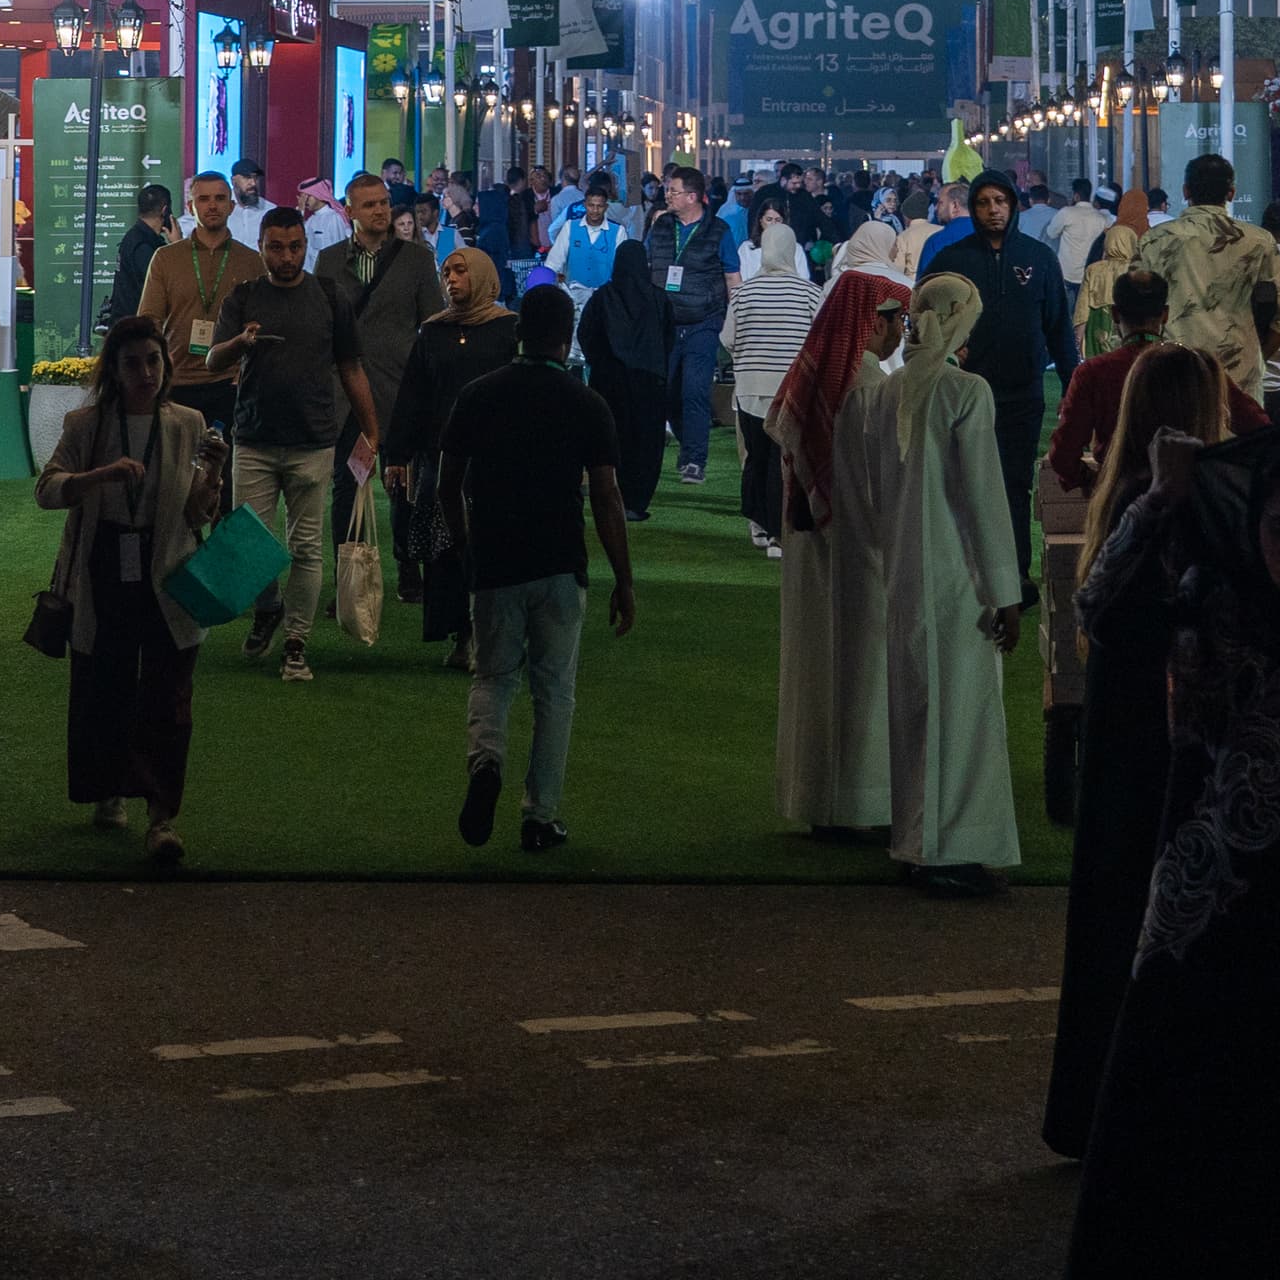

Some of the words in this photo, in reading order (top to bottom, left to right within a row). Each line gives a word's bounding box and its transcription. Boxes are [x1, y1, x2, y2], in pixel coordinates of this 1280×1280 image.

[815, 53, 839, 73] 13
[64, 102, 147, 125] AgiteQ
[762, 98, 827, 113] Entrance
[1185, 123, 1248, 140] AgriQ
